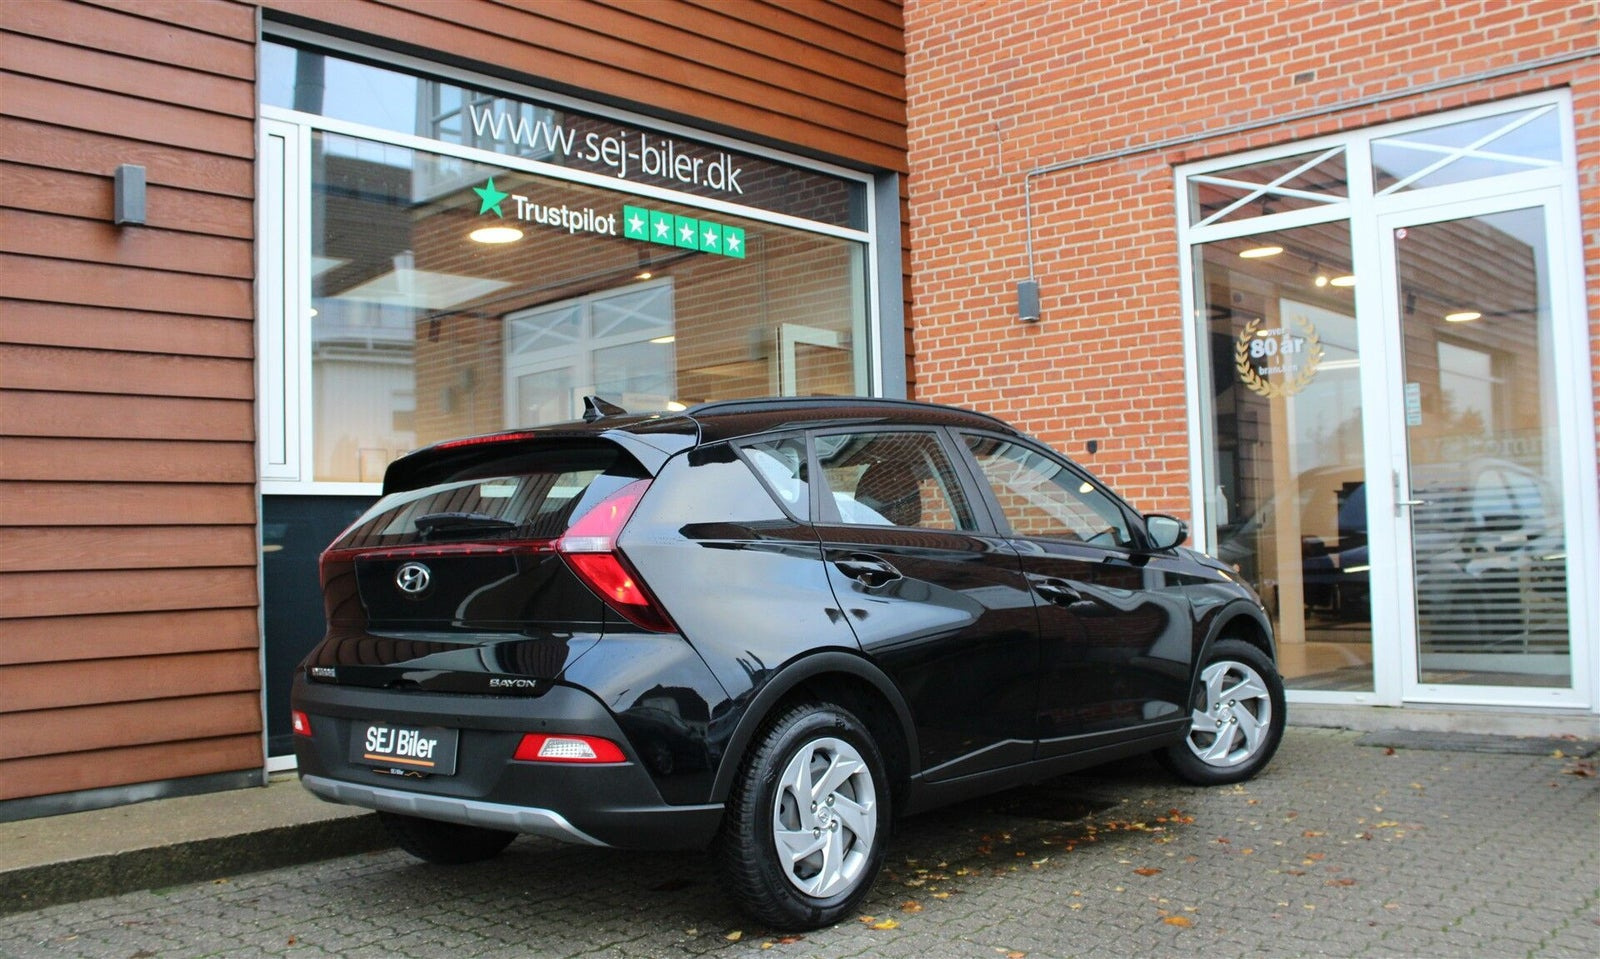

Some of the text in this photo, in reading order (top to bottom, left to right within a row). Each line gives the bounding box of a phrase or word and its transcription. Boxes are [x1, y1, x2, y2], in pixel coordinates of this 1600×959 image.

[469, 104, 744, 195] www.sej-biler.dk
[512, 194, 617, 236] Trustpilot
[1250, 333, 1304, 358] 80 år
[489, 678, 537, 688] BAYON
[365, 726, 437, 759] SEJ Biler
